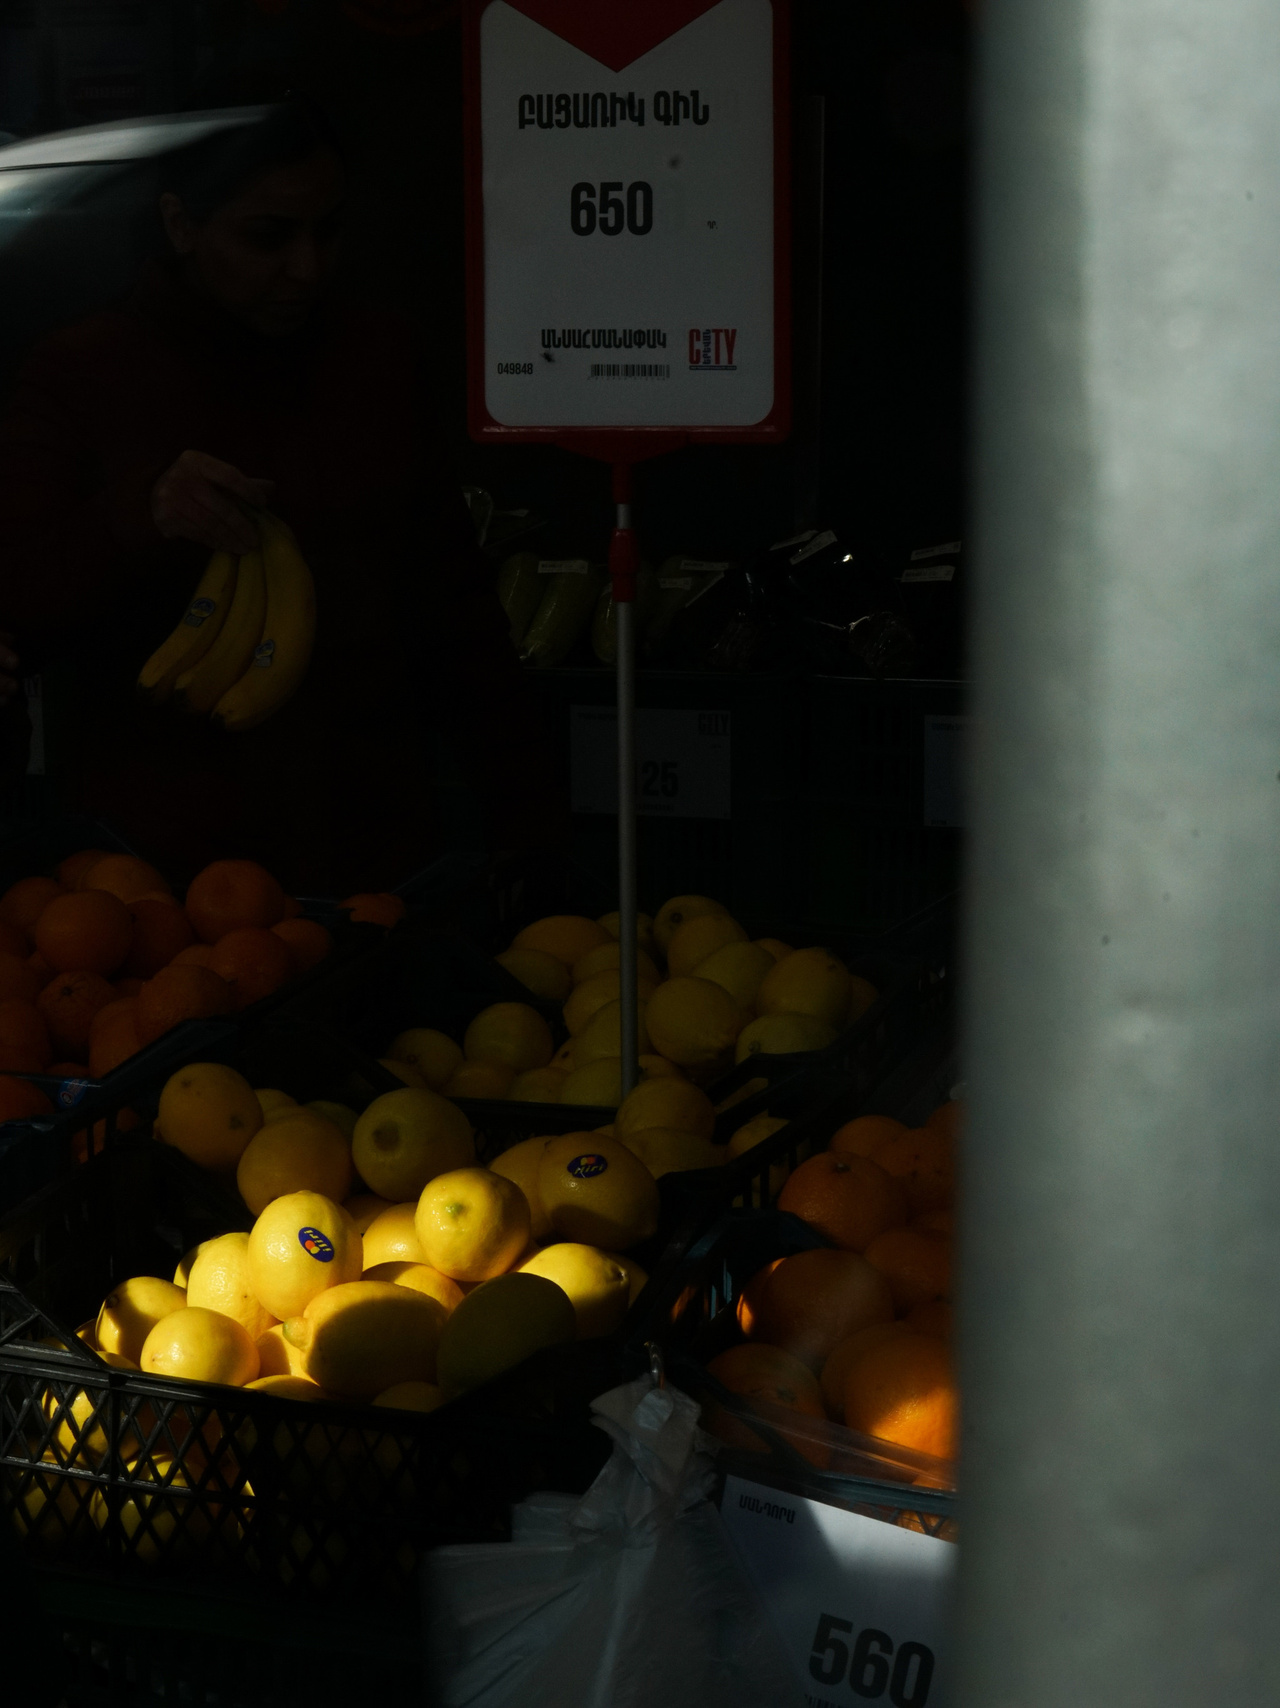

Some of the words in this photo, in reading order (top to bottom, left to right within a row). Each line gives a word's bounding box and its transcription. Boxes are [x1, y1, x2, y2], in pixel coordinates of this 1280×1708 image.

[518, 92, 645, 129] ԲԱՑԱՌԻԿ
[653, 90, 709, 126] ԳԻՆ
[570, 181, 653, 236] 650
[541, 328, 667, 349] ԱՆՍԱՀՄԱՆԱՓԱԿ
[497, 362, 534, 375] 049848
[808, 1612, 935, 1708] 560
